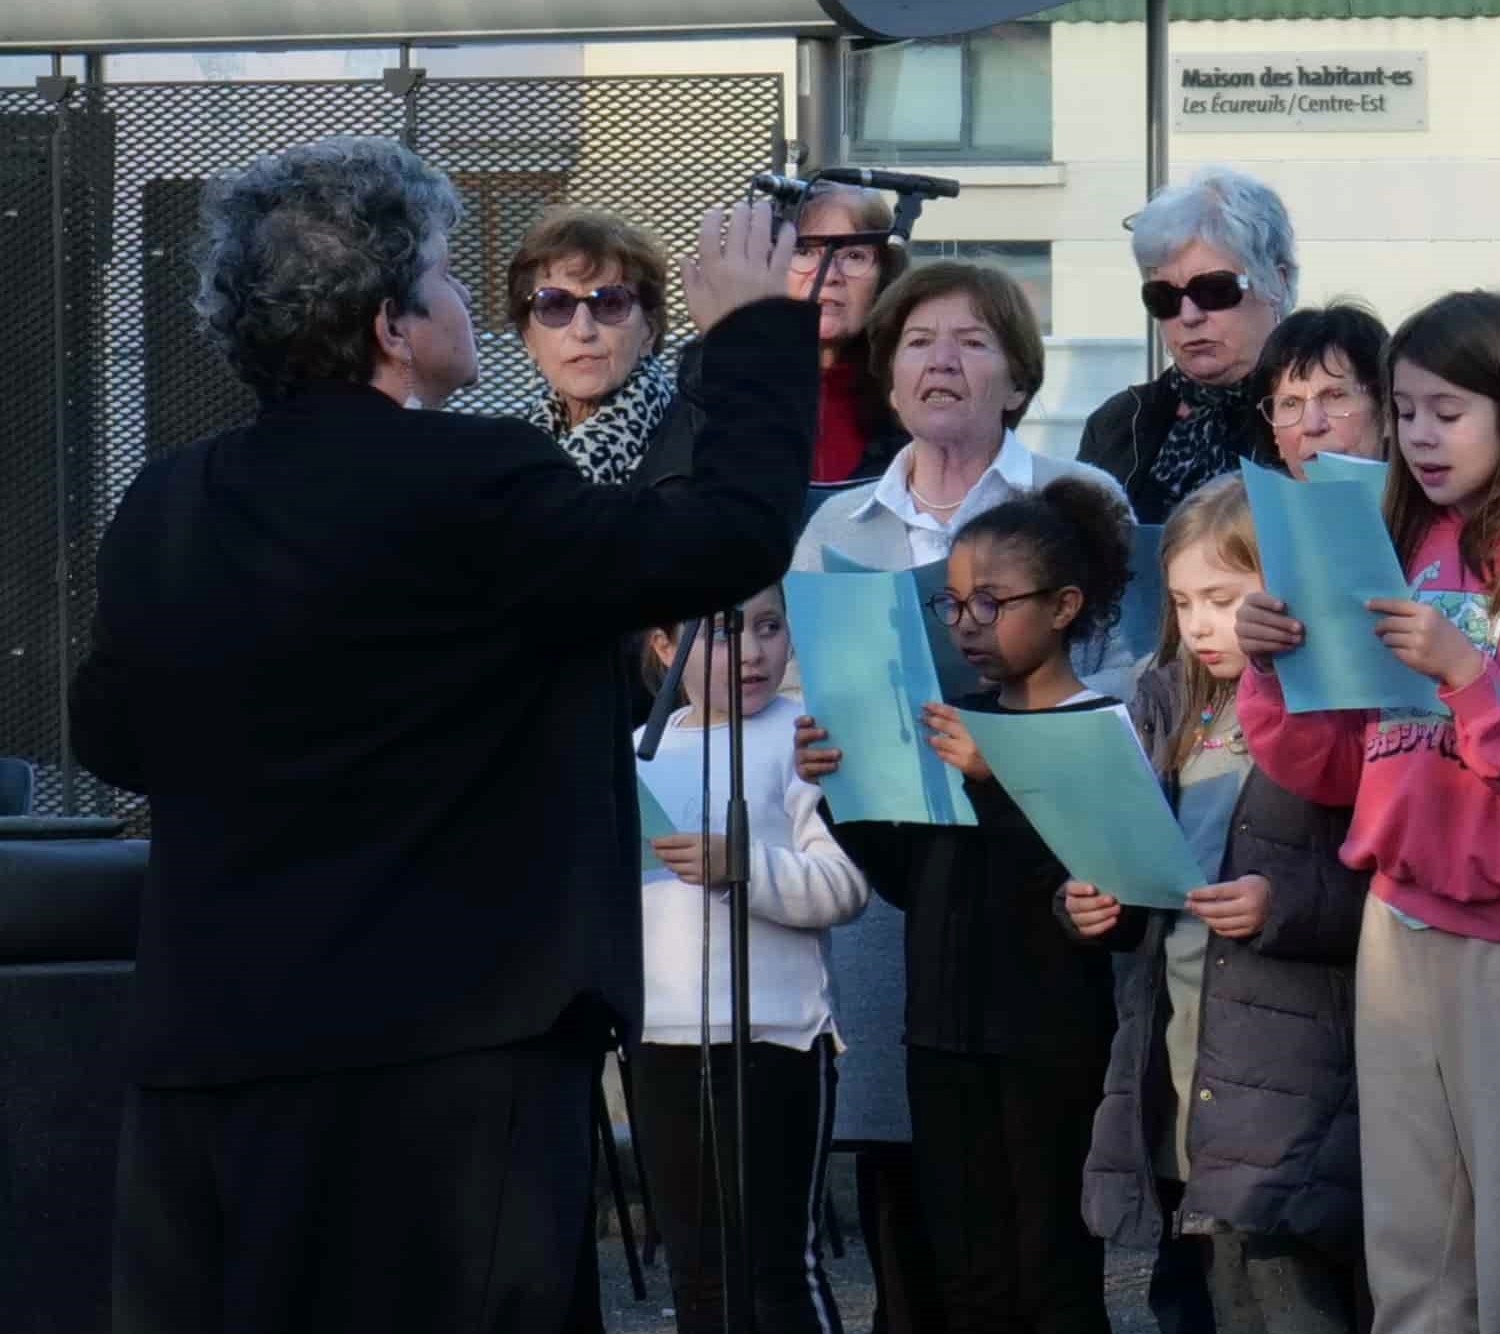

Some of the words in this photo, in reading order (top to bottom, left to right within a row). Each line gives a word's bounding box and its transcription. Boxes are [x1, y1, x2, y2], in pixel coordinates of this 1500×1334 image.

[1182, 68, 1255, 87] Maison
[1260, 67, 1293, 87] des
[1183, 97, 1206, 114] Les
[1211, 93, 1286, 113] Écureuils
